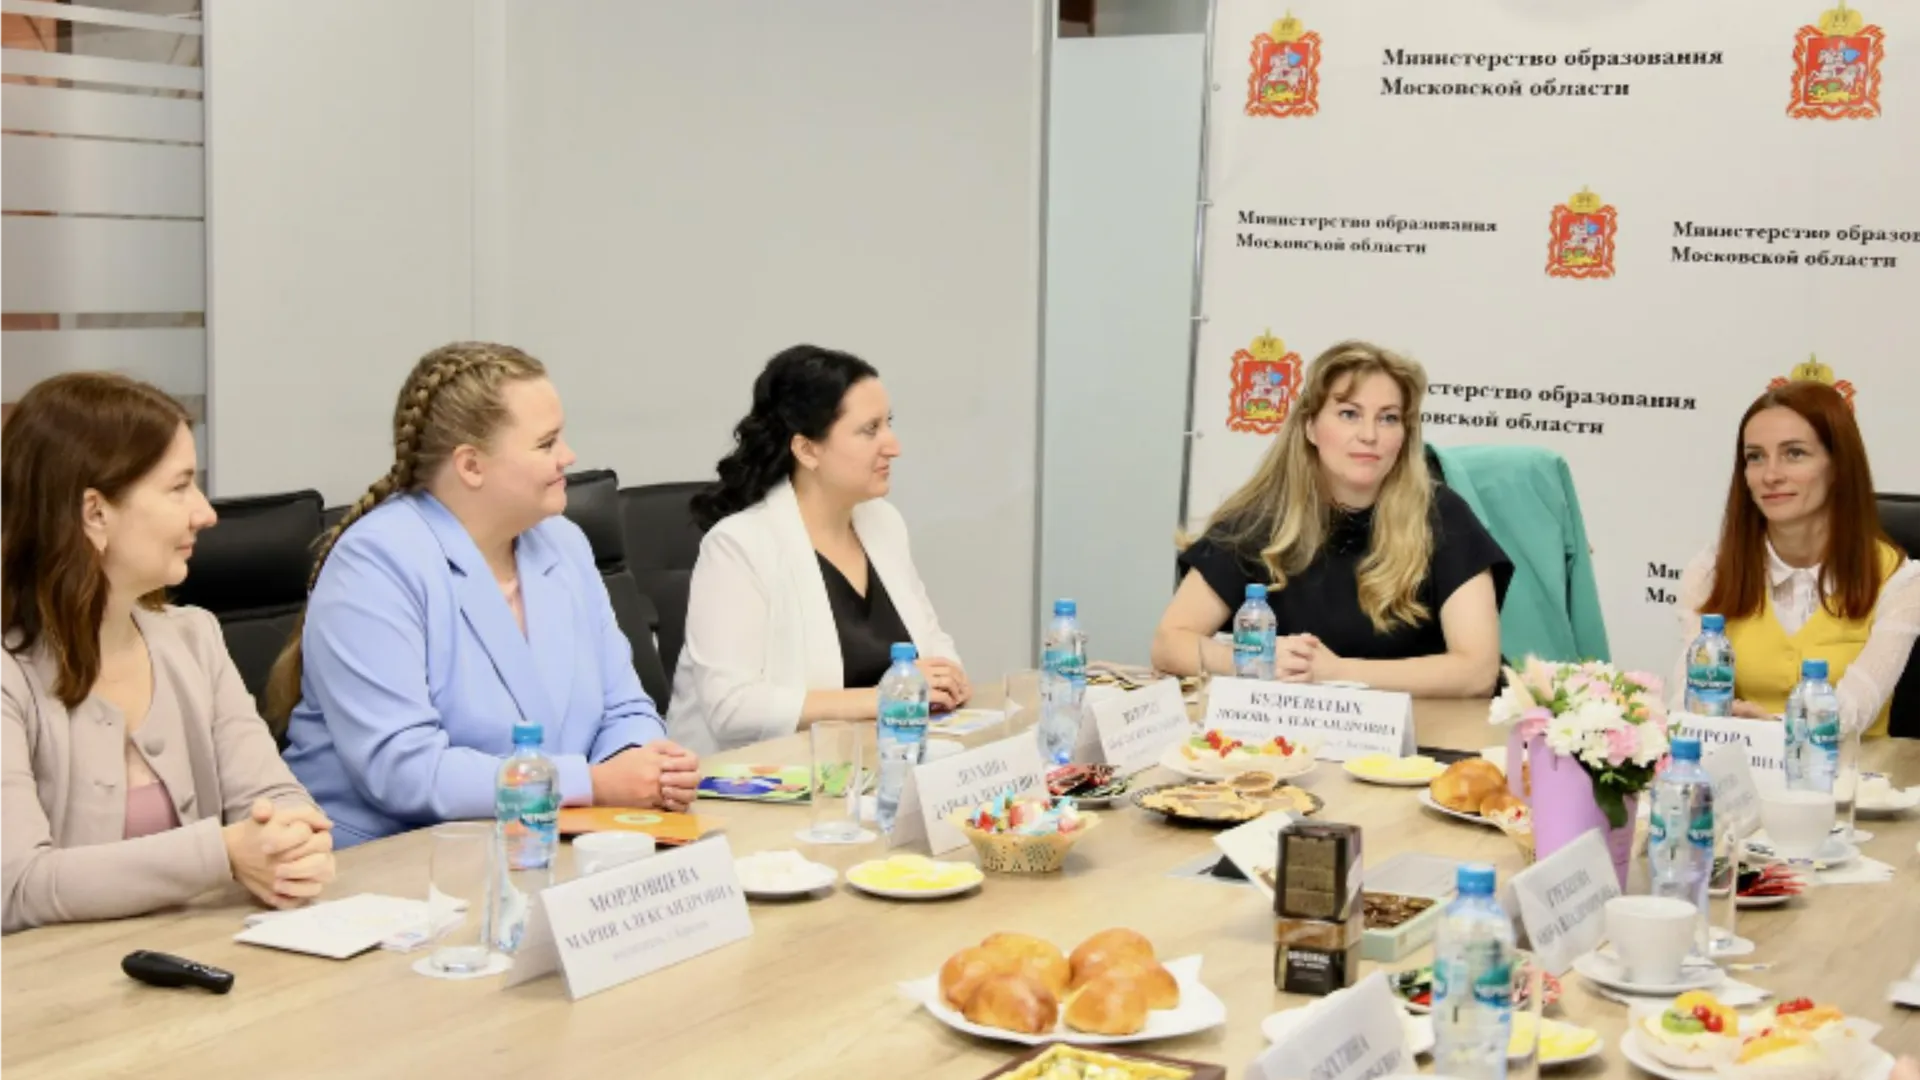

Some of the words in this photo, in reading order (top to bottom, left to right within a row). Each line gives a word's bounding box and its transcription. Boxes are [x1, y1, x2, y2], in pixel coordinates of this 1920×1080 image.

[1382, 48, 1557, 71] Министерство
[1564, 47, 1724, 70] образования
[1380, 77, 1523, 96] Московской
[1529, 77, 1630, 96] области
[1237, 210, 1371, 231] Министерство
[1375, 214, 1498, 233] образования
[1672, 221, 1830, 244] Министерство
[1836, 224, 1920, 245] образов
[1235, 232, 1346, 251] Московской
[1349, 237, 1427, 254] области
[1670, 245, 1799, 265] Московской
[1804, 249, 1897, 268] области
[1427, 382, 1532, 402] стерство
[1537, 385, 1697, 410] образования
[1420, 410, 1499, 428] овской
[1505, 413, 1605, 435] области
